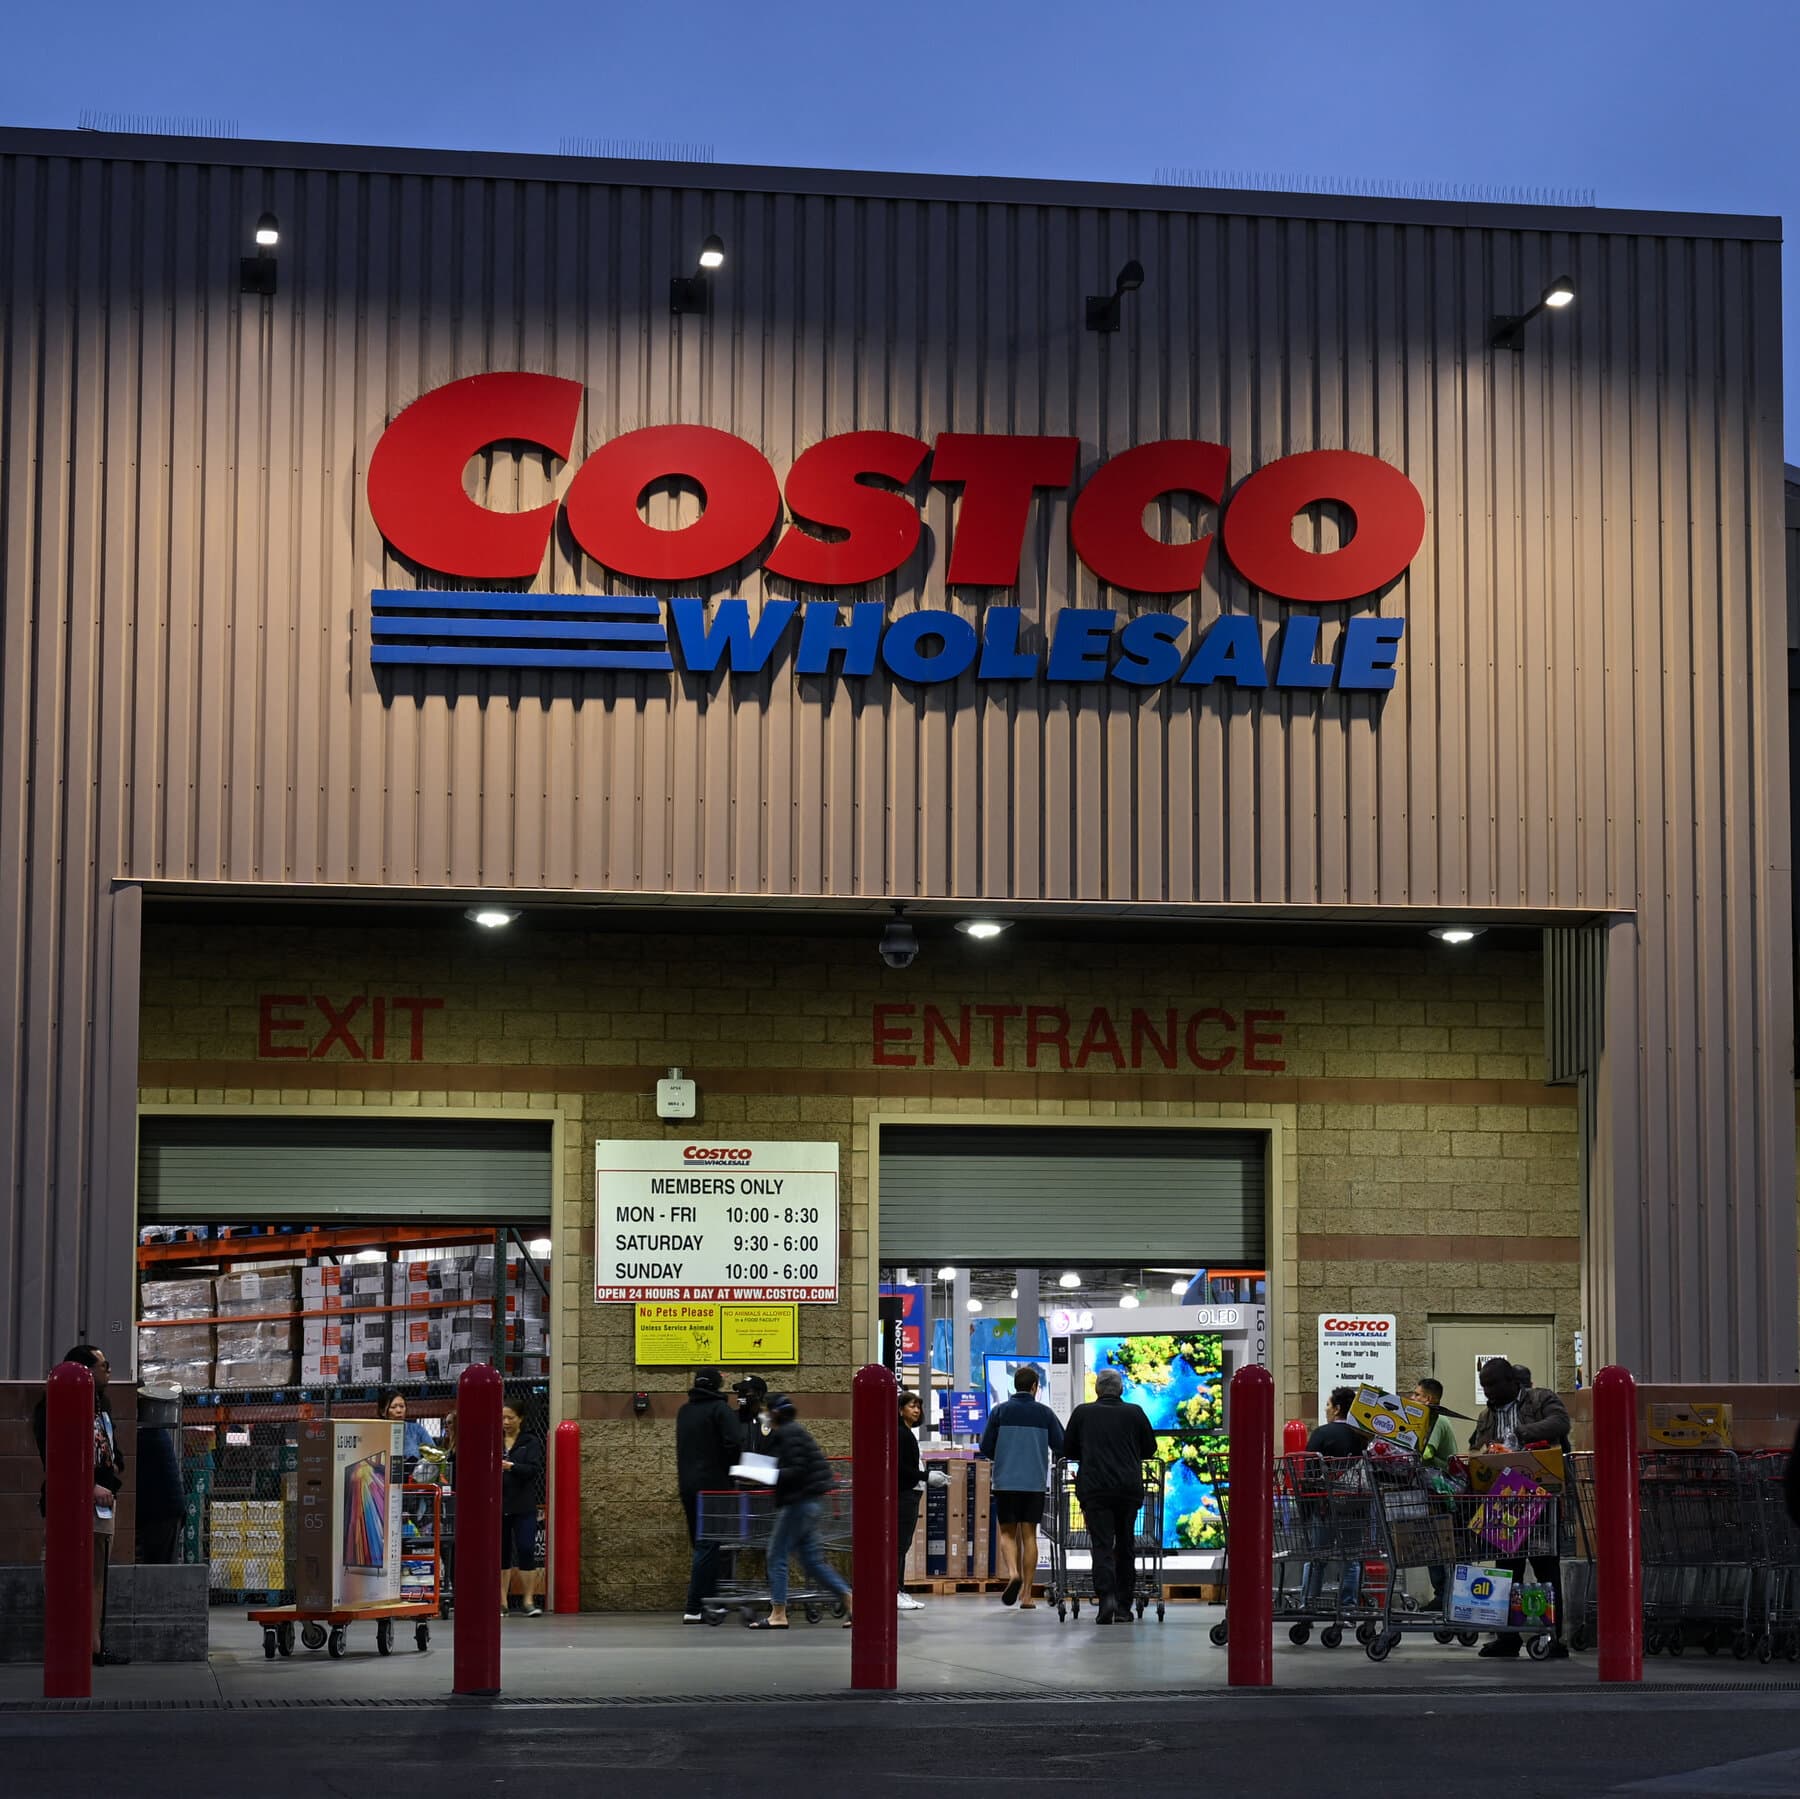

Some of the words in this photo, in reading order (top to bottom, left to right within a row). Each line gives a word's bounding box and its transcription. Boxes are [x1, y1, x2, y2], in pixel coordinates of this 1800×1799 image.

[368, 371, 1425, 601] COSTCO
[669, 598, 1406, 690] WHOLESALE
[258, 995, 445, 1061] EXIT
[872, 1003, 1287, 1072] ENTRANCE
[683, 1146, 752, 1160] COSTCO
[651, 1178, 735, 1195] MEMBERS
[740, 1179, 784, 1195] ONLY
[616, 1206, 655, 1222] MON
[671, 1207, 696, 1222] FRI
[726, 1207, 769, 1223] 10:00
[784, 1208, 819, 1223] 8:30
[616, 1234, 703, 1250] SATURDAY
[734, 1235, 768, 1251] 9:30
[783, 1236, 819, 1251] 6:00
[615, 1262, 683, 1279] SUNDAY
[725, 1263, 768, 1279] 10:00
[783, 1264, 818, 1279] 6:00
[598, 1288, 626, 1299] OPEN
[629, 1288, 642, 1299] 24
[645, 1288, 680, 1299] HOURS
[683, 1289, 691, 1299] A
[694, 1289, 715, 1299] DAY
[718, 1289, 731, 1299] AT
[733, 1289, 834, 1300] WWW.COSTCO.COM
[640, 1307, 652, 1317] No
[656, 1307, 677, 1317] Pets
[681, 1307, 714, 1317] Please
[1198, 1309, 1238, 1326] OLED
[1070, 1311, 1093, 1330] LG
[1256, 1310, 1265, 1332] LG
[1324, 1318, 1389, 1331] COSTCO
[895, 1320, 903, 1347] Neo
[1370, 1350, 1379, 1358] Day
[895, 1349, 903, 1381] QLED
[1365, 1373, 1374, 1381] Day
[304, 1513, 324, 1529] 65
[1473, 1582, 1490, 1596] all
